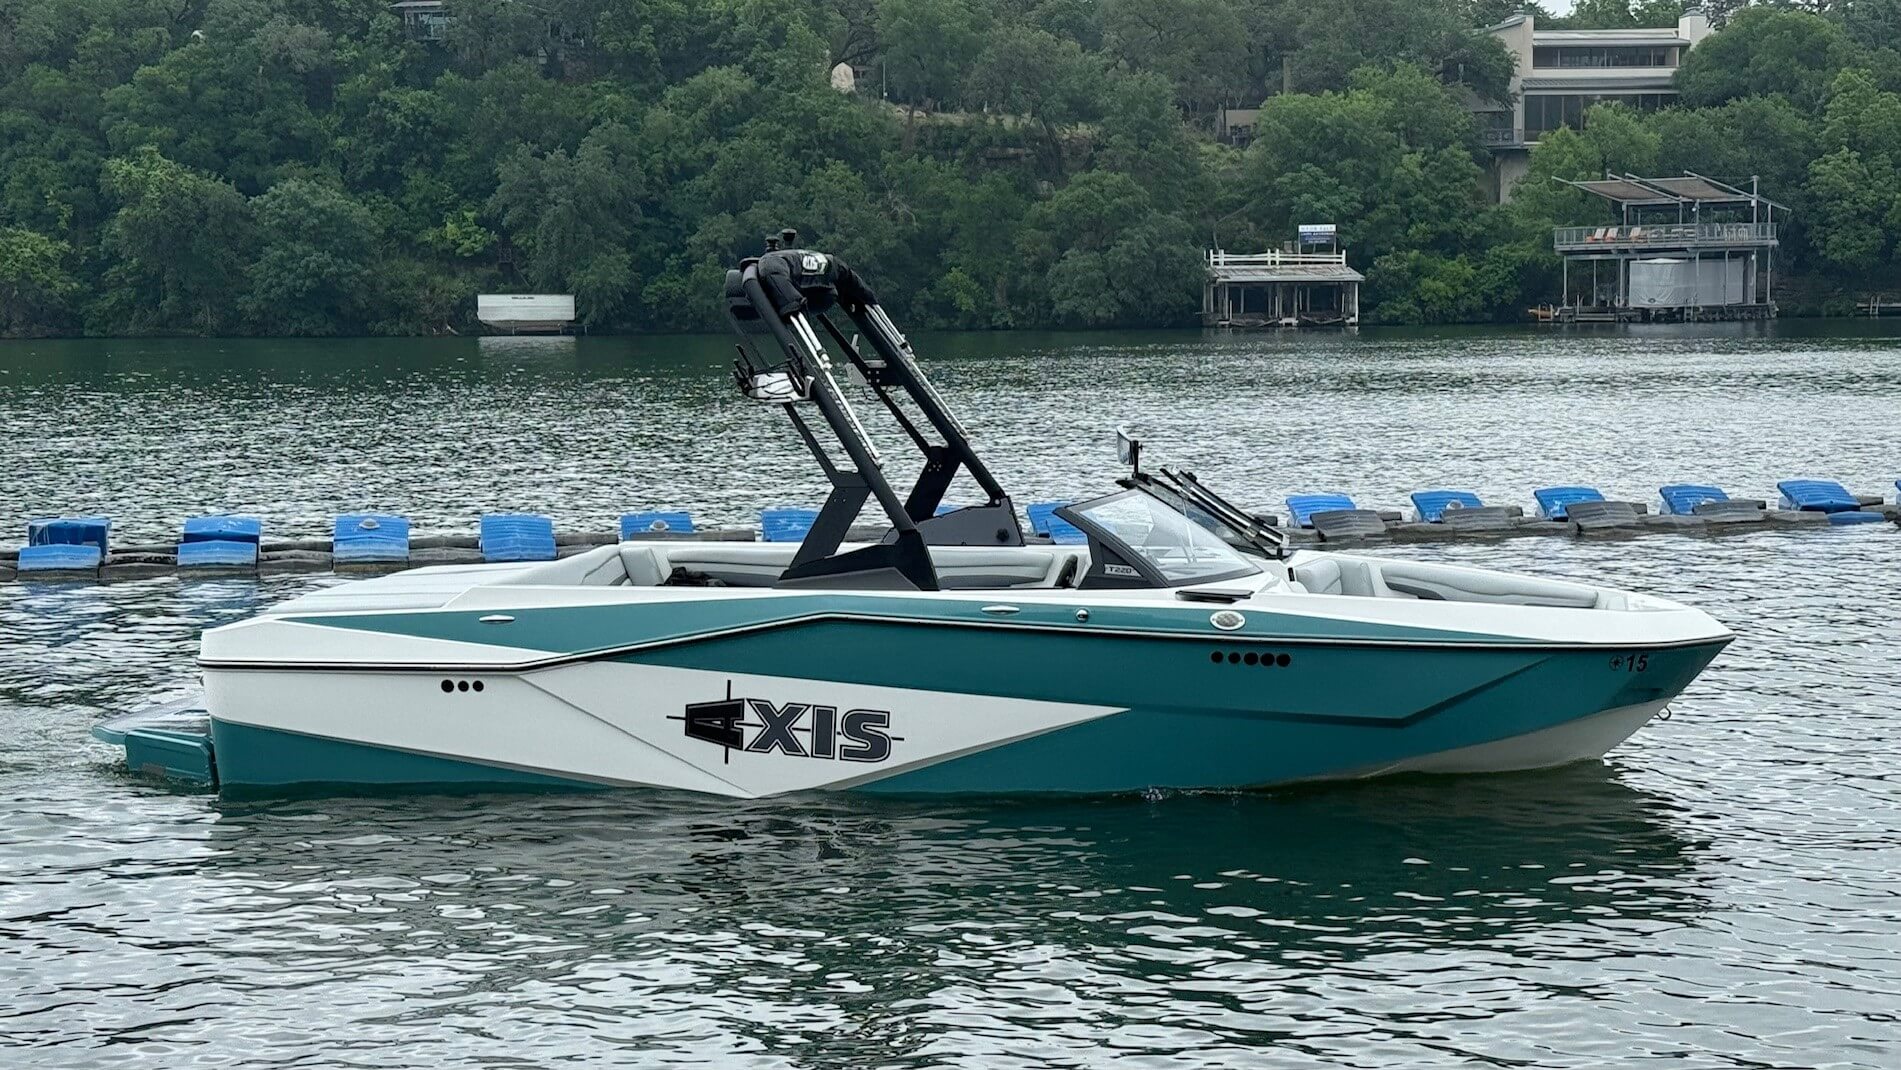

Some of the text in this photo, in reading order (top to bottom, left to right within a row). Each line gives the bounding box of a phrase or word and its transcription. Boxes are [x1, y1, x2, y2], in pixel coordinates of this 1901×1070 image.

[1109, 566, 1132, 574] T220
[1626, 654, 1648, 672] 15
[684, 698, 892, 763] AXIS
